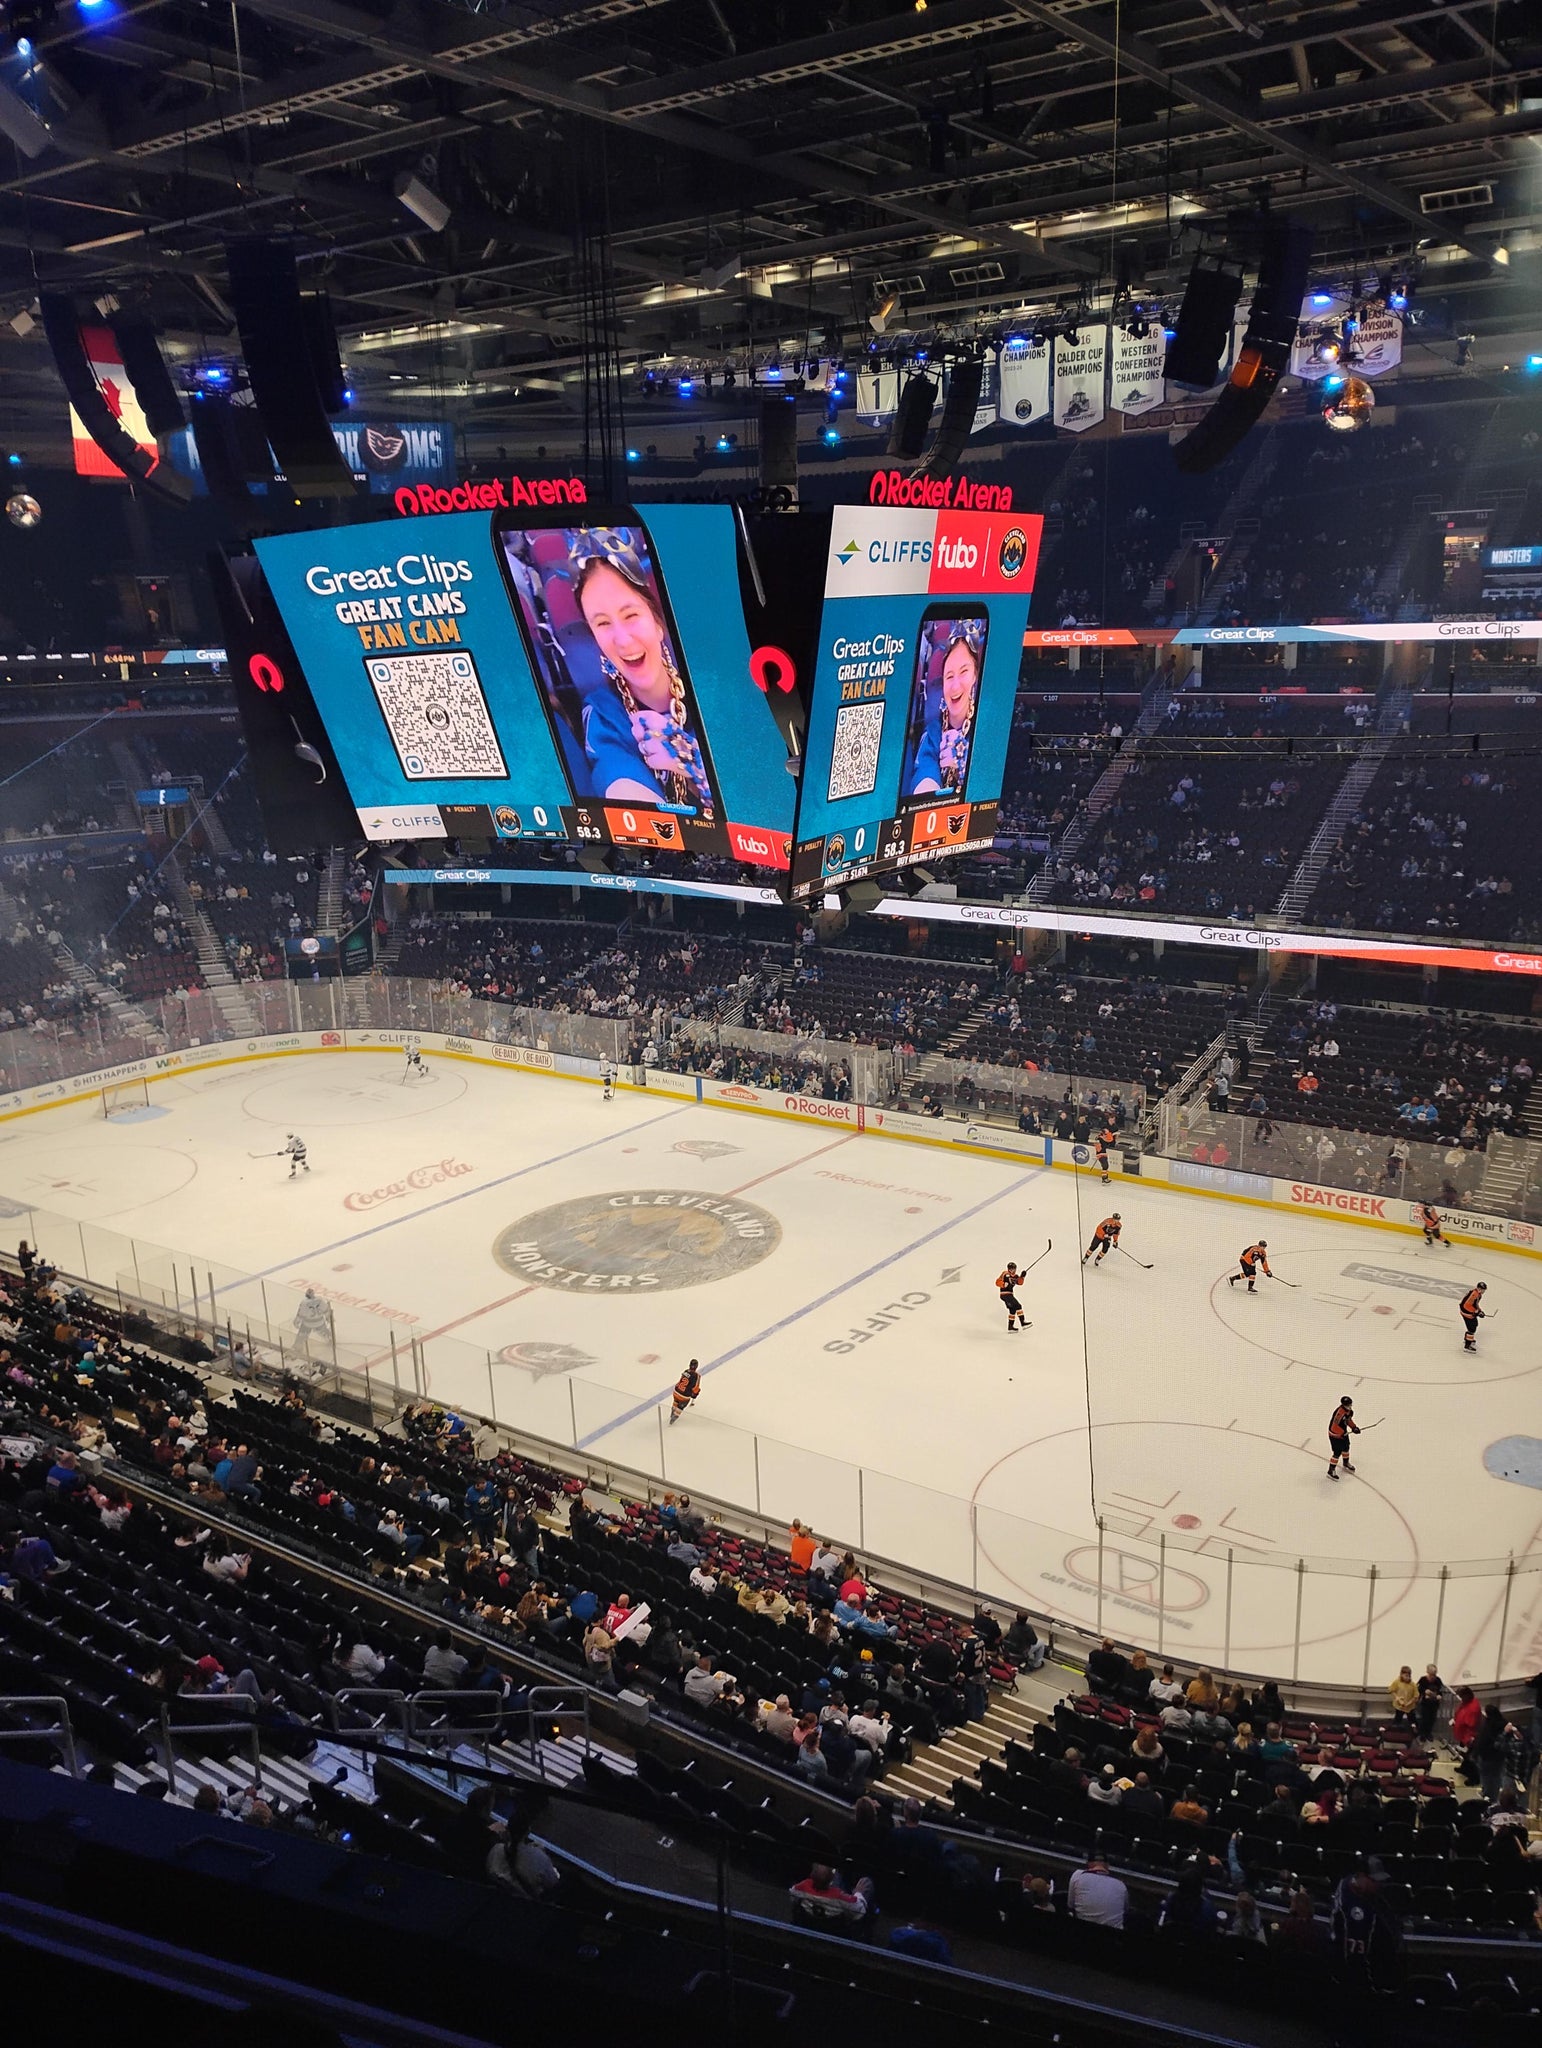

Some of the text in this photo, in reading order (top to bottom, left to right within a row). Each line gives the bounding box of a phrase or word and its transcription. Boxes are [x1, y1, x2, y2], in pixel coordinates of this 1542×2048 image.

[1360, 320, 1393, 331] DIVISION
[1003, 348, 1046, 362] CHAMPIONS
[1056, 347, 1104, 364] CALDER CUP
[1121, 344, 1158, 356] WESTERN
[861, 362, 893, 373] BOER
[1057, 361, 1103, 378] CHAMPIONS
[1114, 356, 1163, 371] CONFERENCE
[1116, 369, 1160, 383] CHAMPIONS
[872, 378, 881, 409] 1
[417, 477, 587, 512] Rocket Arena
[886, 471, 1013, 511] Rocket Arena
[868, 536, 977, 569] CLIFFS fubo
[1491, 550, 1532, 564] MONSTERS
[305, 554, 473, 596] Great Clips
[335, 592, 467, 625] GREAT CAMS
[357, 618, 461, 650] FAN CAM
[1041, 631, 1097, 644] Great Clips
[1210, 628, 1275, 641] Great Clips
[1438, 622, 1522, 638] Great Clips
[195, 649, 226, 660] Great
[833, 633, 905, 659] Great Clips
[838, 659, 895, 681] GREAT CAMS
[841, 678, 886, 701] FAN CAM
[392, 816, 441, 827] CLIFFS
[533, 806, 548, 827] 0
[622, 811, 636, 831] 0
[693, 820, 716, 829] PENALTY
[926, 812, 937, 834] 0
[577, 826, 601, 839] 58.3
[854, 827, 865, 851] 0
[737, 834, 768, 856] fubo
[884, 840, 905, 858] 58.3
[897, 857, 908, 867] BUY
[908, 850, 929, 865] ONLINE
[929, 849, 937, 858] AT
[434, 870, 491, 881] Great Clips
[590, 874, 637, 889] Great Clips
[823, 872, 849, 888] AMOUNT:
[960, 907, 1030, 925] Great Clips
[1200, 927, 1282, 948] Great Clips
[1494, 954, 1541, 970] Great
[379, 1033, 422, 1044] CLIFFS
[82, 1065, 138, 1086] HITS HAPPEN
[726, 1089, 753, 1099] SERVPRO
[800, 1098, 850, 1121] Rocket
[979, 1134, 1004, 1143] CENTURY
[343, 1157, 473, 1212] Coca-Cola
[1291, 1184, 1386, 1219] SEATGEEK
[608, 1194, 765, 1239] CLEVELAND
[1439, 1213, 1469, 1229] drug
[1472, 1221, 1504, 1233] mart
[510, 1240, 661, 1287] MONSTERS
[822, 1291, 932, 1355] CLIFFS
[1040, 1572, 1067, 1585] CAR
[1069, 1581, 1110, 1601] PARTS
